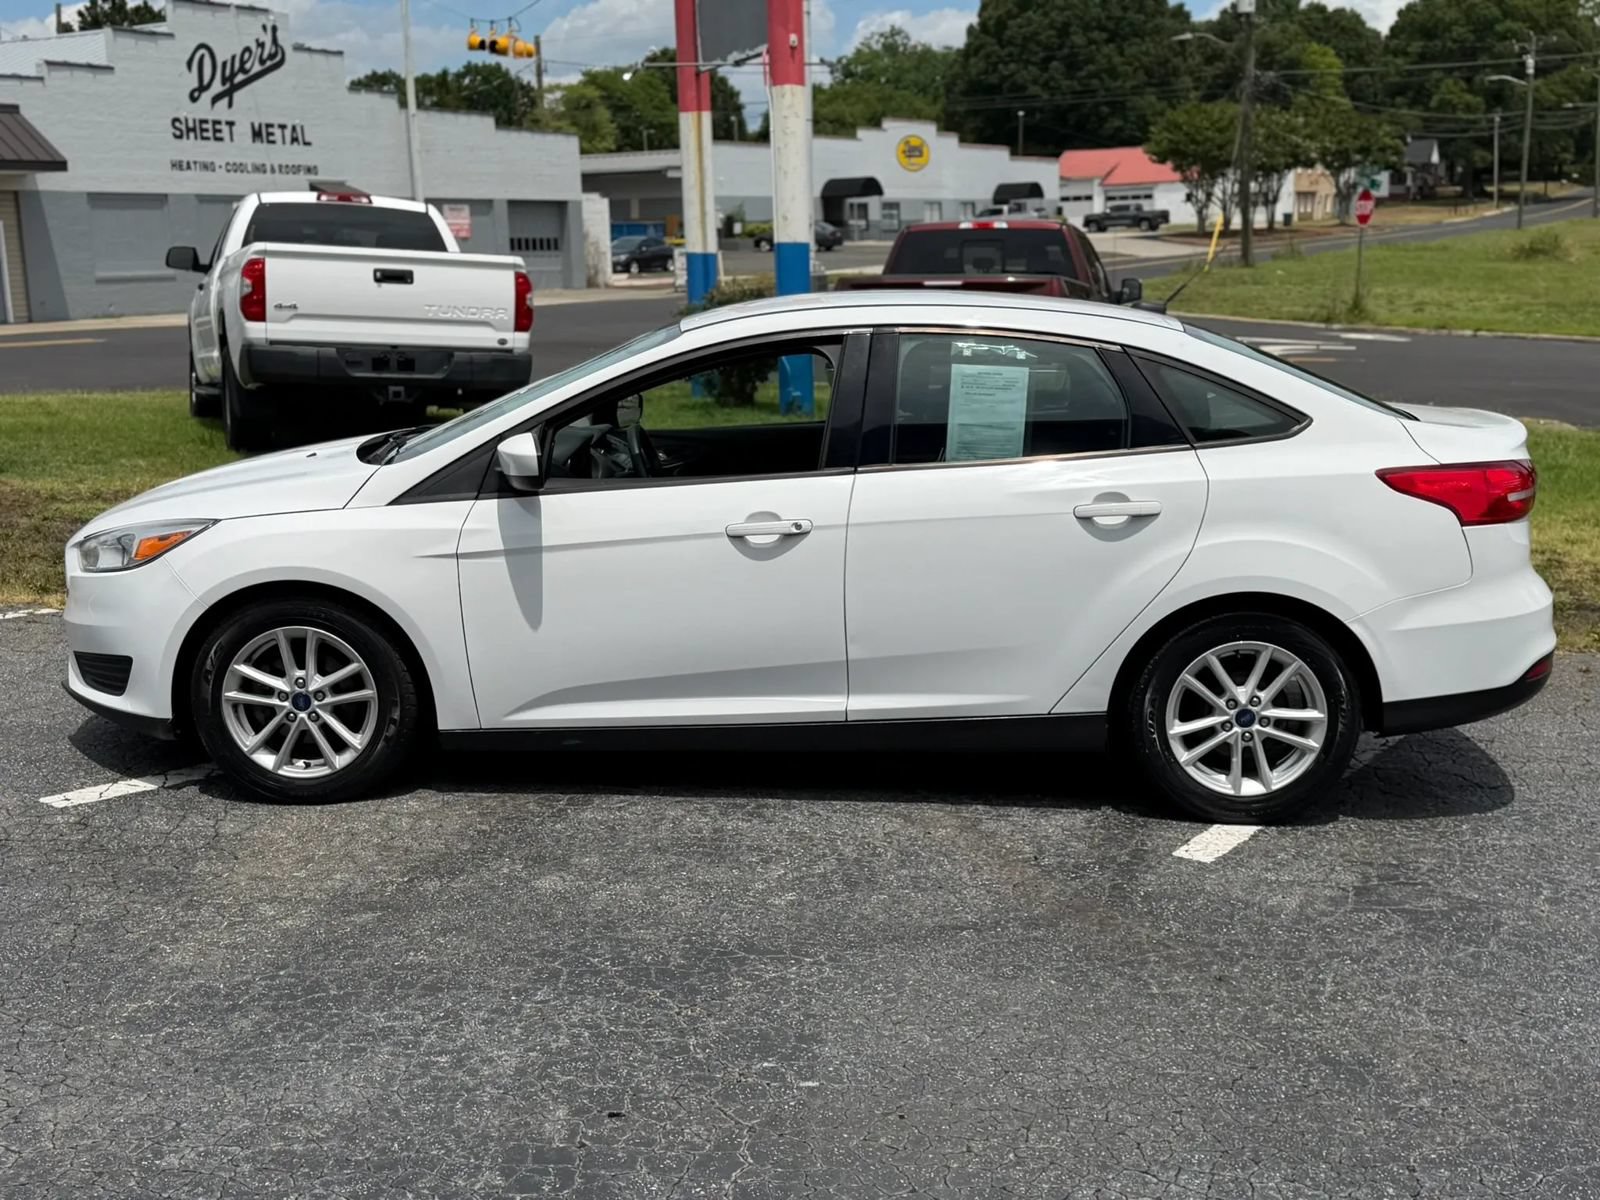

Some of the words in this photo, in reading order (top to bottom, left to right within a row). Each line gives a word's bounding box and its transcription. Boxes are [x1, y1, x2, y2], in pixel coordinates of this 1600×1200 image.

[186, 23, 285, 110] Dyer's
[171, 116, 236, 142] SHEET
[250, 121, 313, 147] METAL
[170, 160, 216, 172] HEATING
[225, 161, 267, 174] COOLING
[278, 163, 319, 176] ROOFING
[423, 304, 509, 320] TUNDRA
